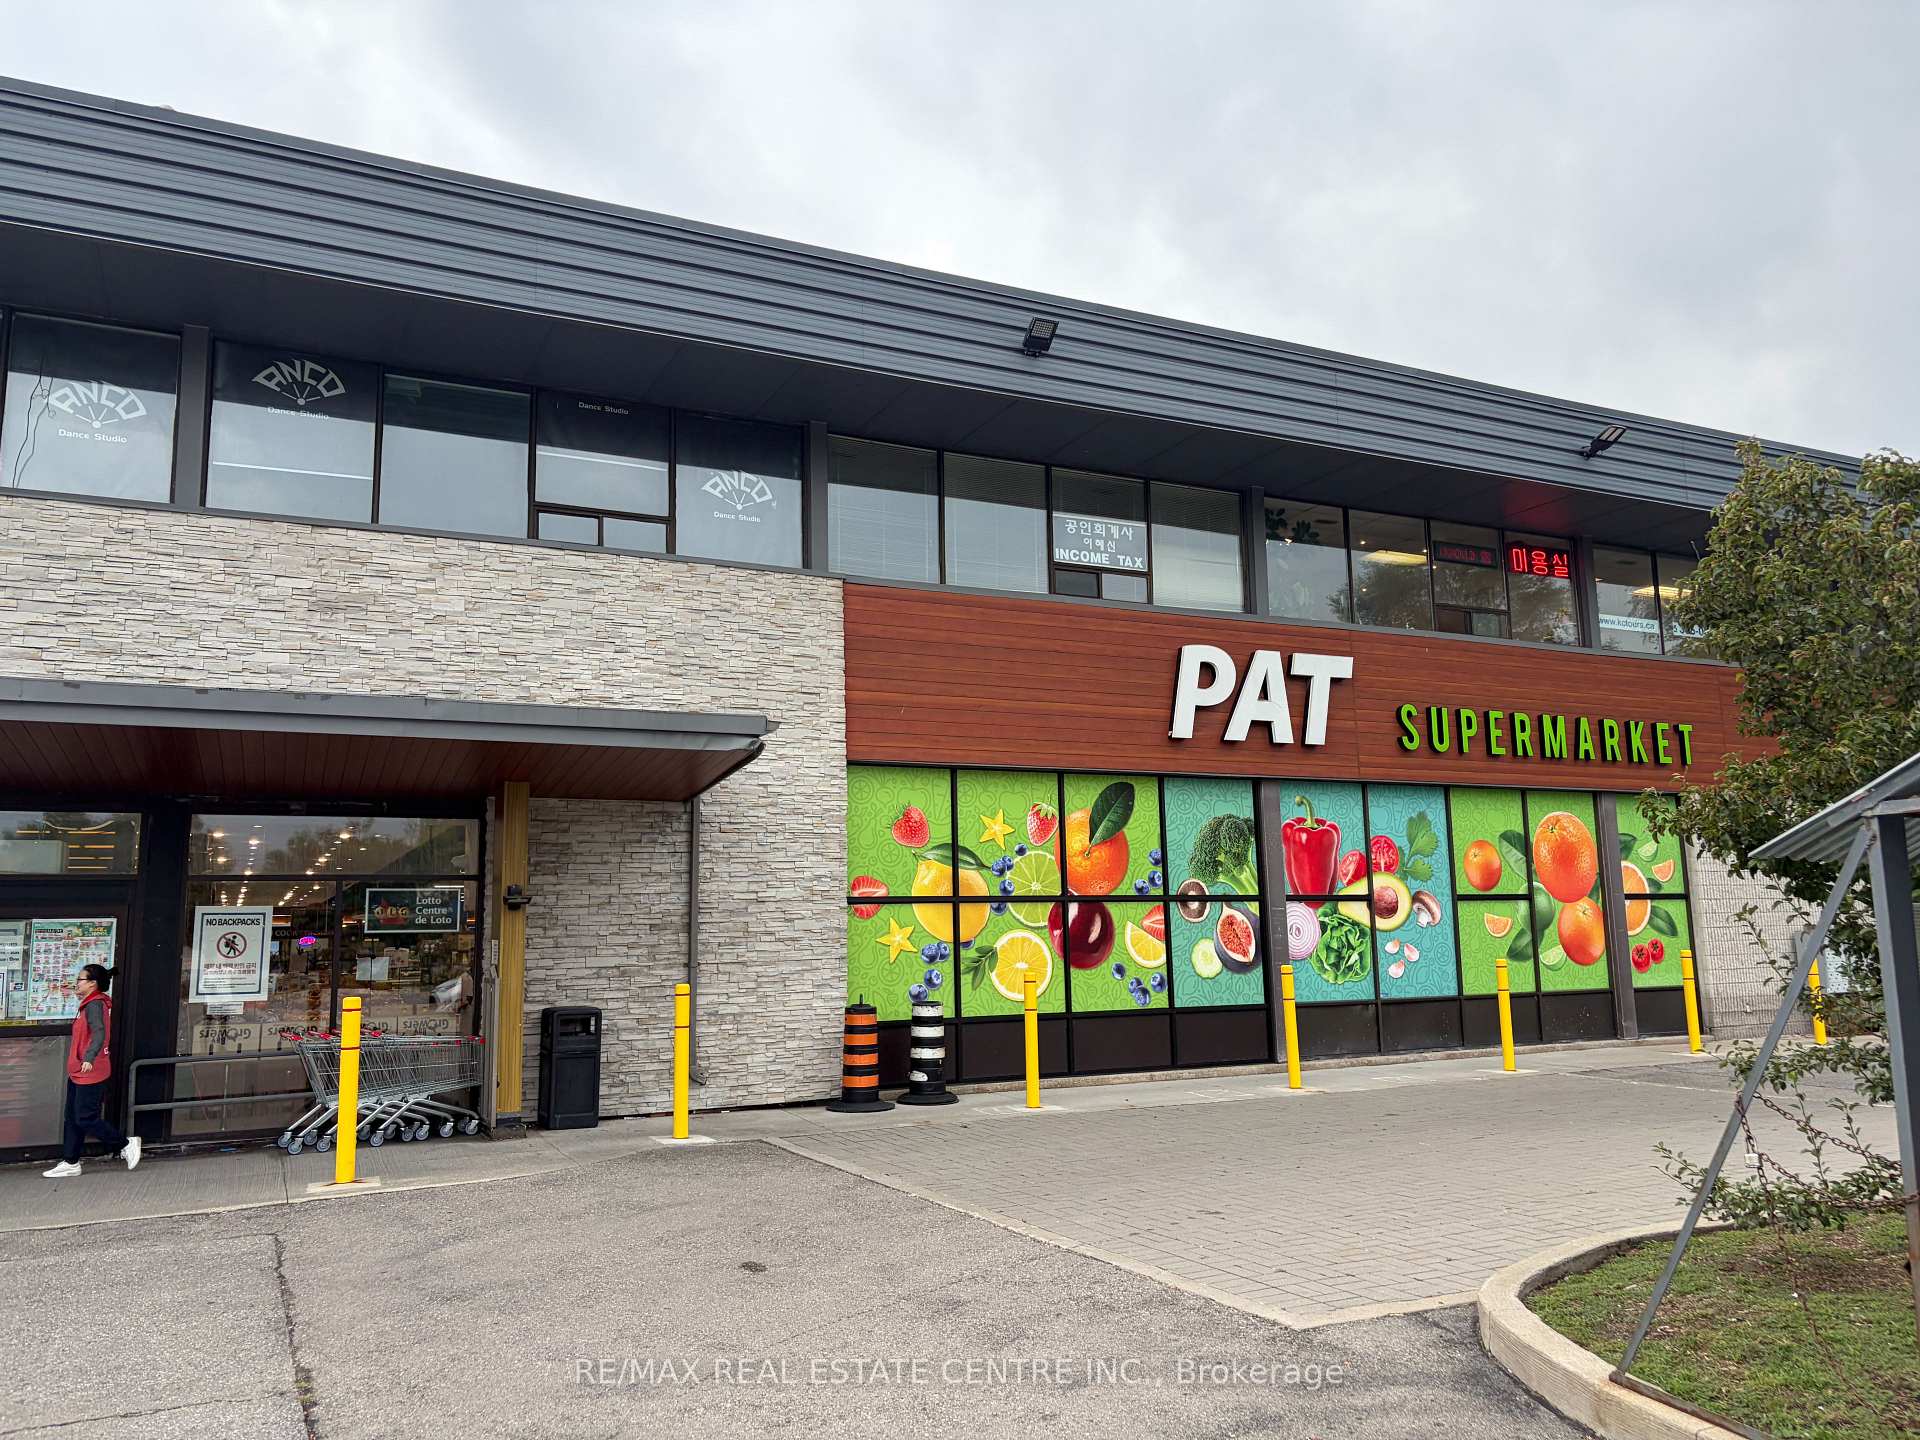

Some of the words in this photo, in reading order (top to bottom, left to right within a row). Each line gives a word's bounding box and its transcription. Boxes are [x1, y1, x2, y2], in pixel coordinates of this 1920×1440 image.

[267, 406, 295, 416] Dance
[299, 410, 329, 420] Studio
[578, 401, 601, 411] Dance
[604, 405, 629, 415] Studio
[58, 428, 90, 439] Dance
[94, 433, 128, 443] Studio
[713, 511, 736, 519] Dance
[738, 514, 761, 522] Studio
[1064, 519, 1134, 541] 공인회계사
[1055, 547, 1110, 565] INCOME
[1117, 554, 1143, 569] TAX
[1512, 547, 1569, 577] 미용실
[1168, 643, 1354, 746] PAT
[1396, 702, 1694, 766] SUPERMARKET
[416, 896, 442, 905] Lotto
[415, 906, 448, 915] Centre
[206, 918, 218, 926] NO
[218, 918, 260, 926] BACKPACKS
[415, 915, 427, 924] de
[430, 915, 452, 924] Loto
